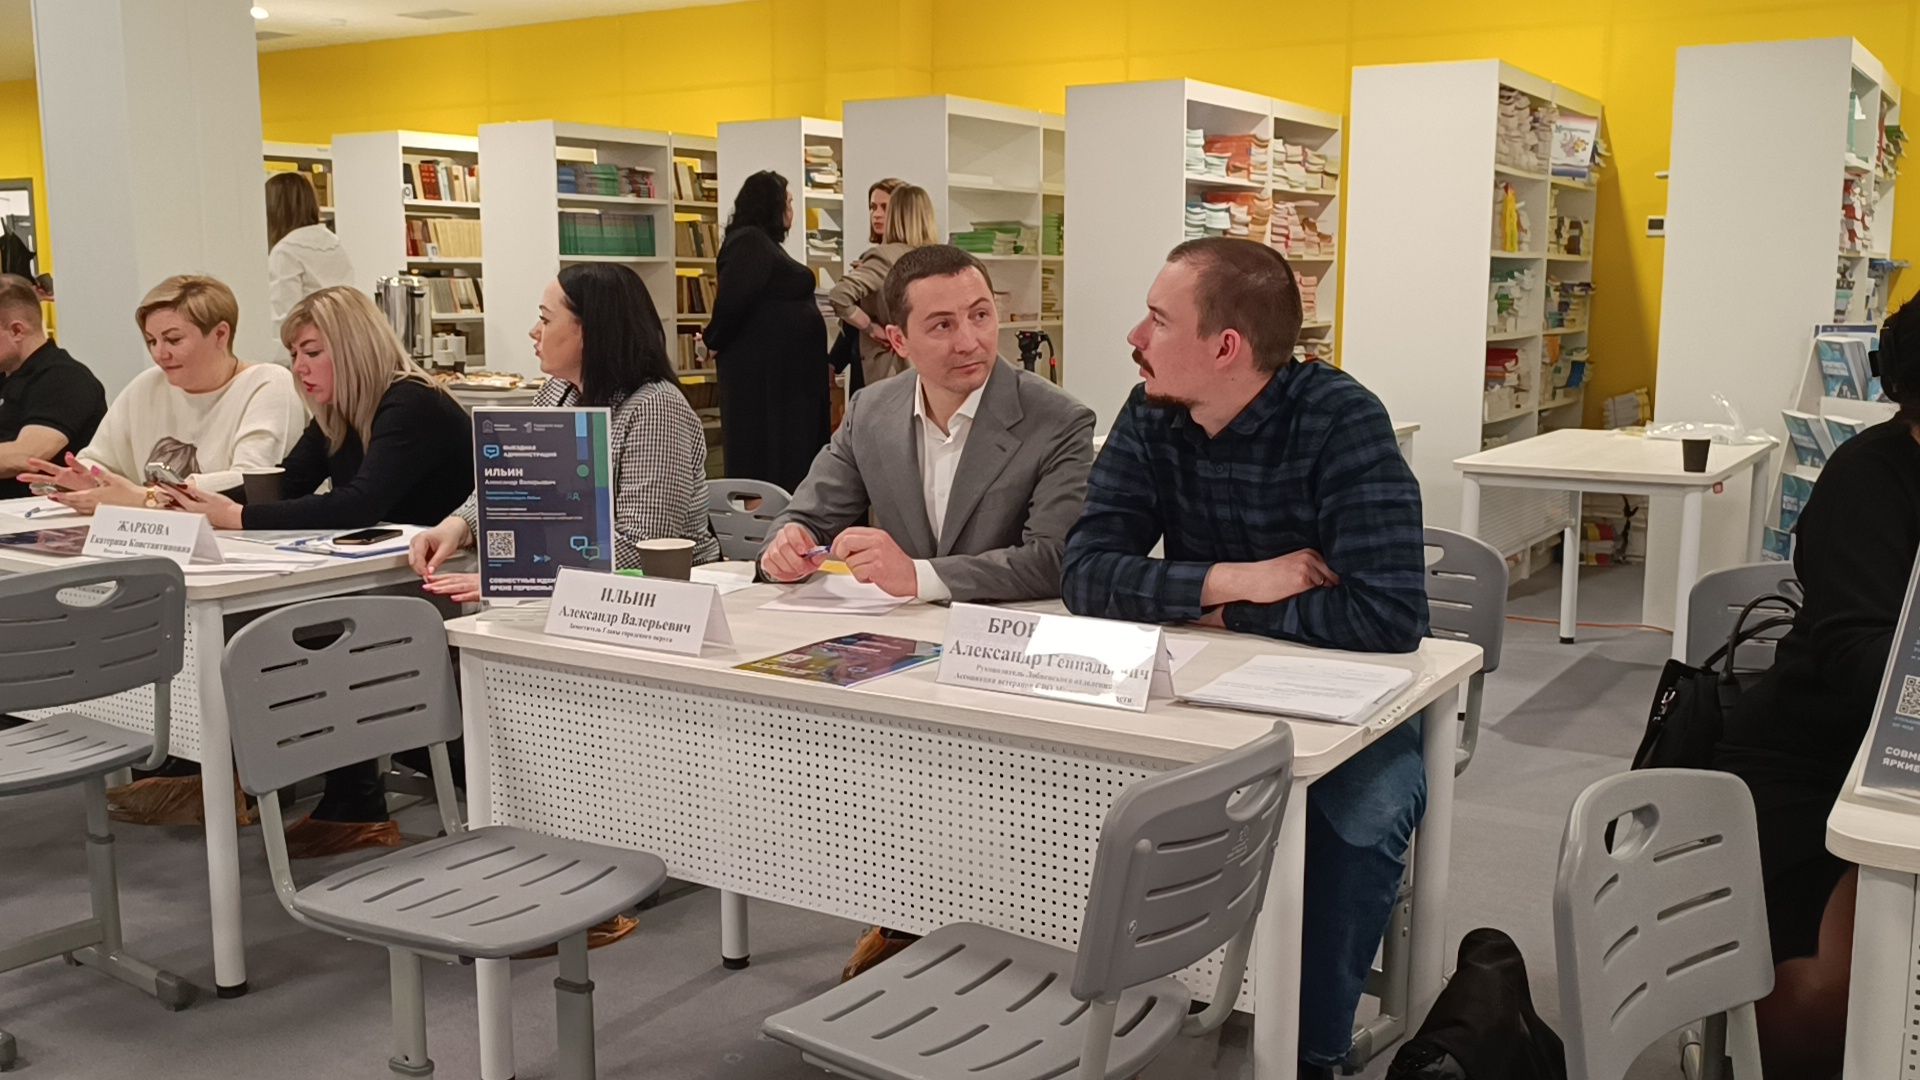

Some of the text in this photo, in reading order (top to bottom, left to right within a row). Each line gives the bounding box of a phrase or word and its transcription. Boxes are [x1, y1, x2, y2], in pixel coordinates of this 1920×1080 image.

[484, 467, 524, 477] ИЛЬИН
[116, 520, 170, 537] ЖАРКОВА
[89, 534, 127, 548] Екатерина
[128, 537, 192, 554] Константиновна
[600, 587, 657, 608] ИЛЬИН
[558, 605, 691, 634] Александр Валерьевич
[1882, 757, 1920, 774] ЯРКИЕ
